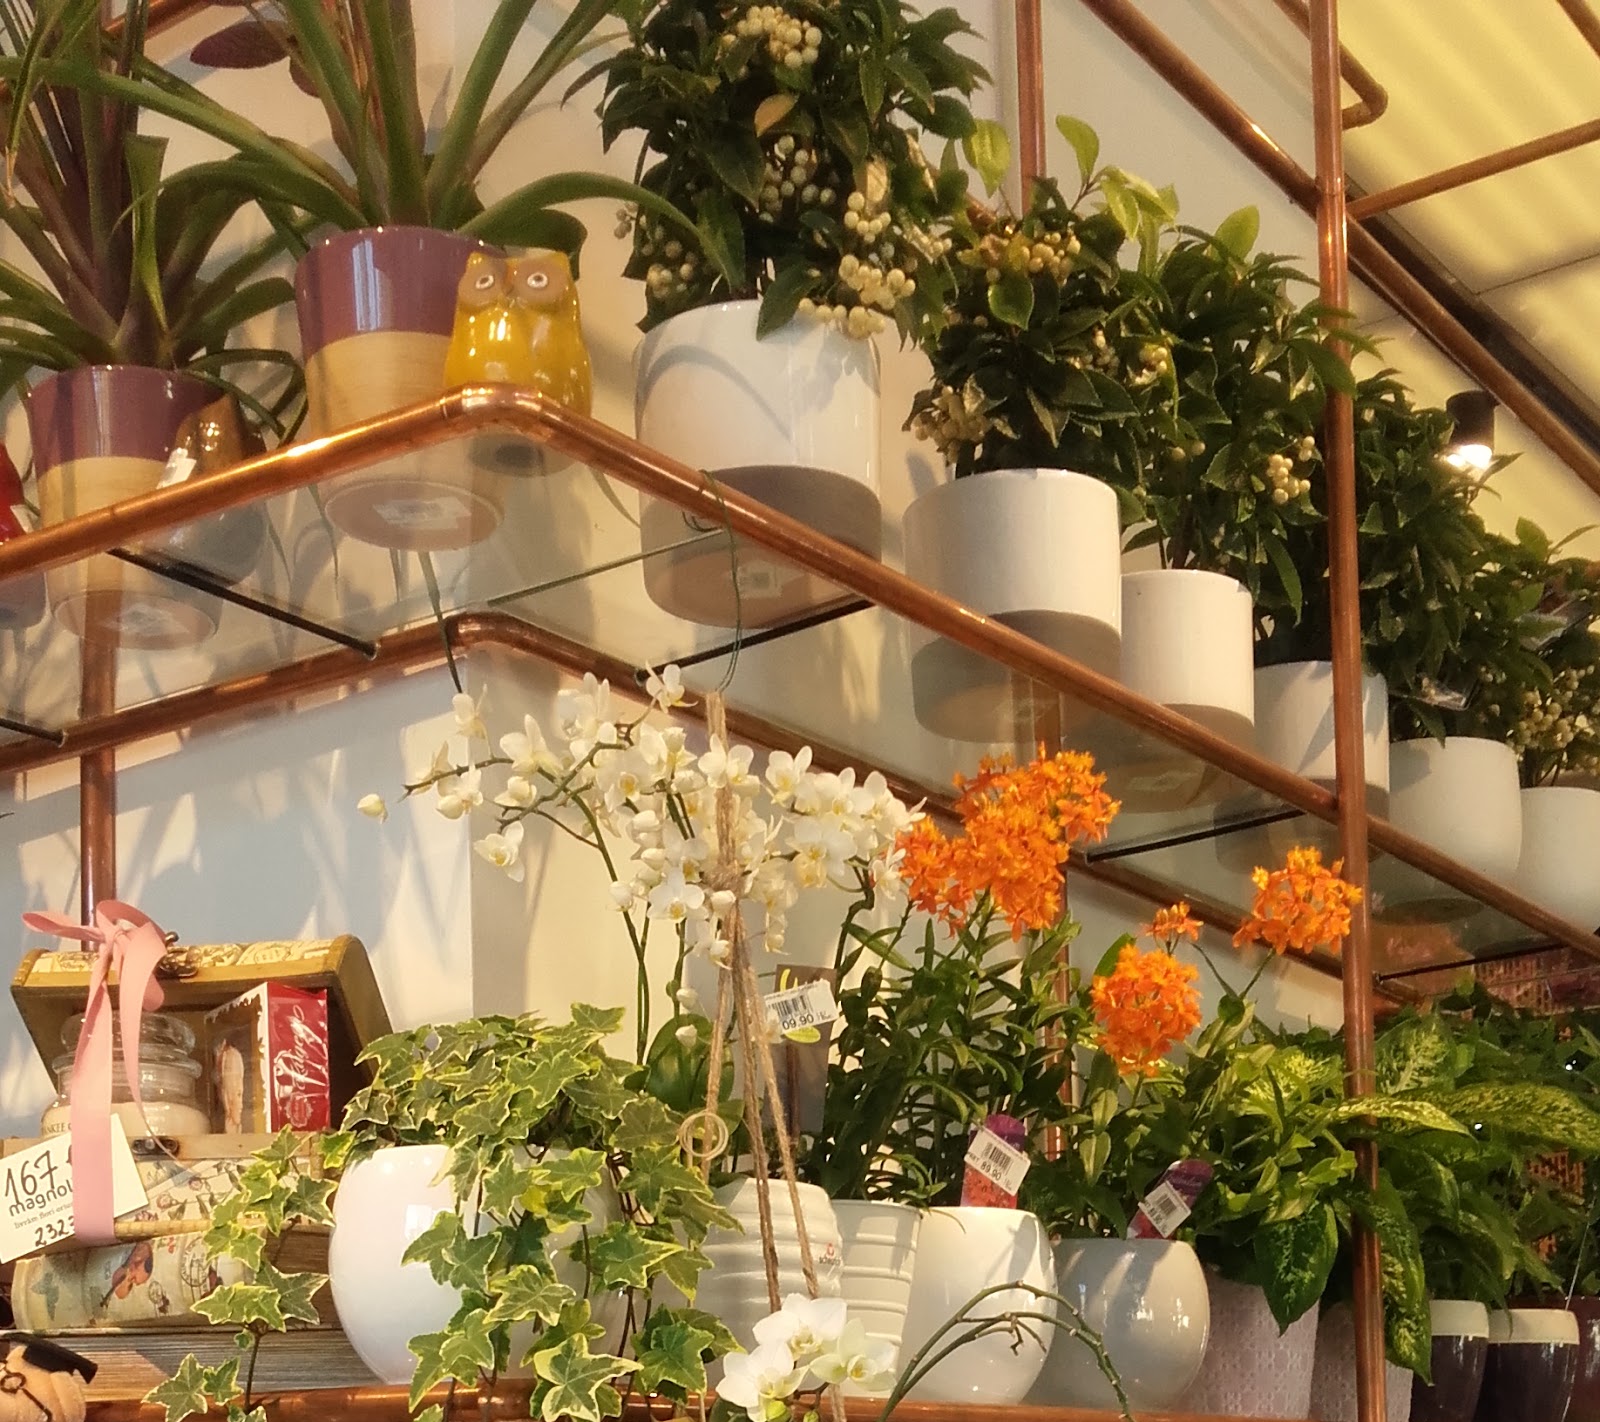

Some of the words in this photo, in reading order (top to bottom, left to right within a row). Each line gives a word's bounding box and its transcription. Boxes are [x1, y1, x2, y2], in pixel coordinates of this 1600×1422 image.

[4, 1150, 59, 1205] 167
[980, 1161, 1002, 1181] 89.90
[9, 1179, 74, 1217] magnol
